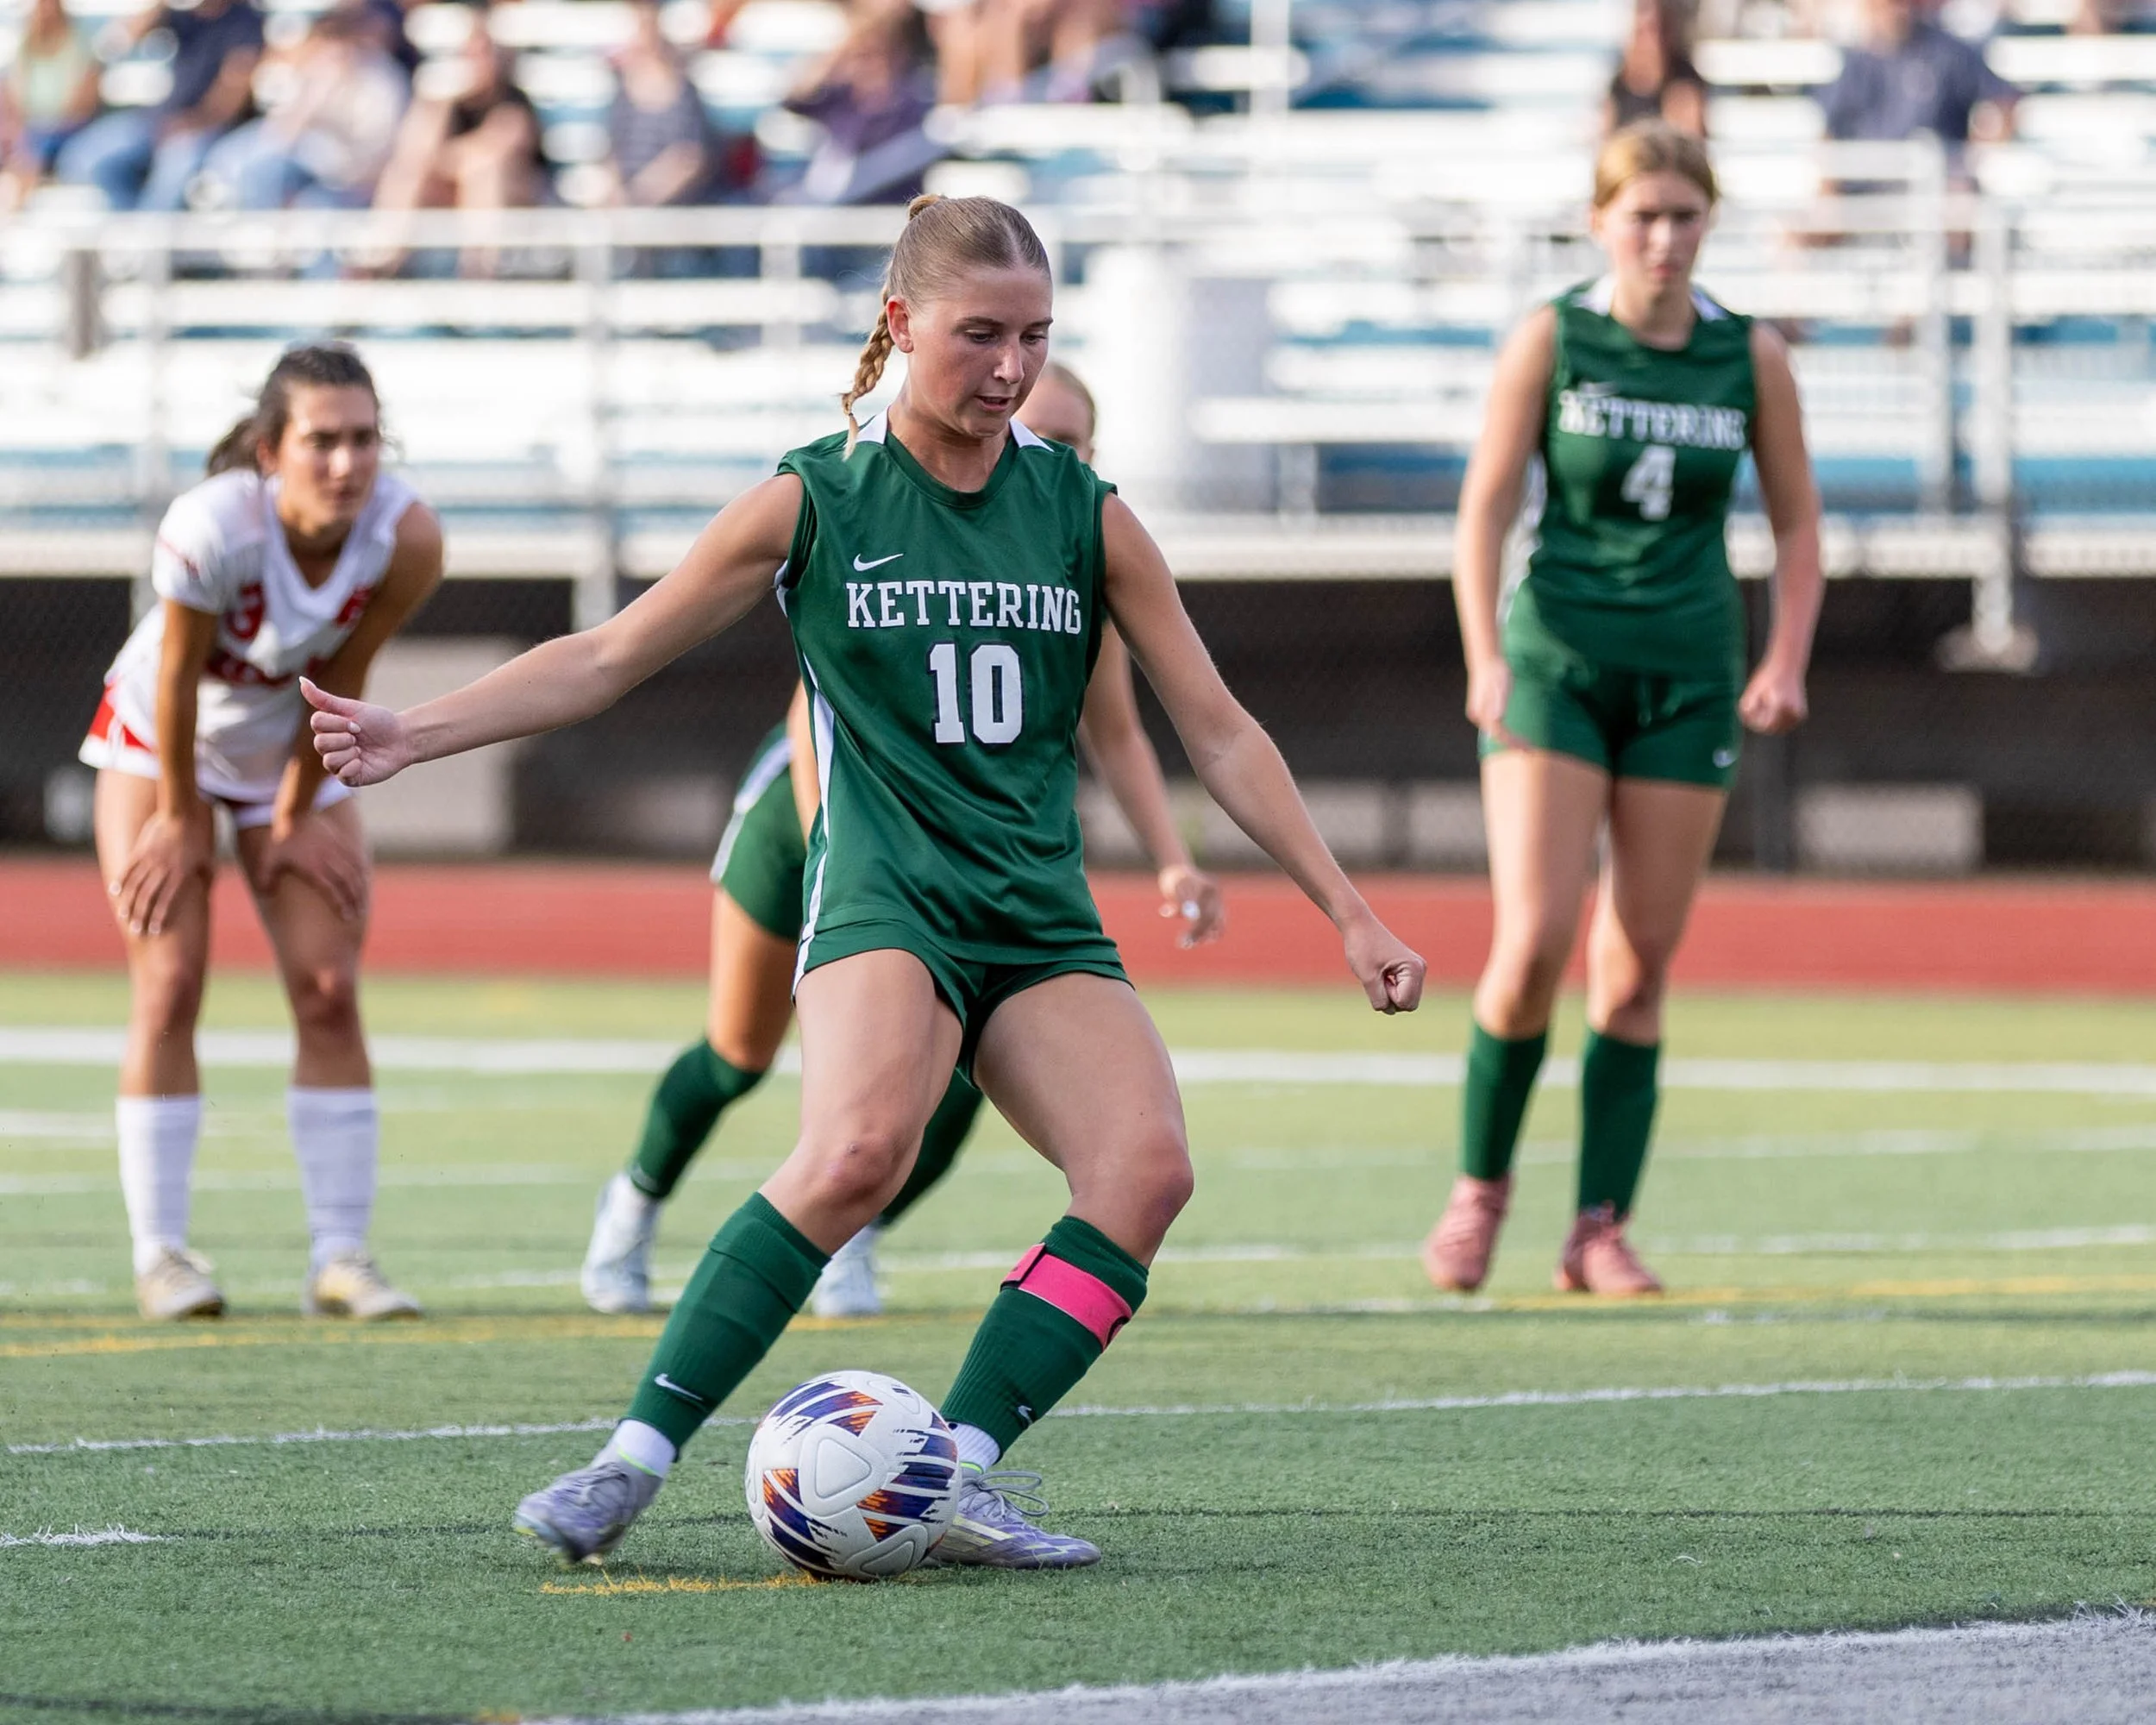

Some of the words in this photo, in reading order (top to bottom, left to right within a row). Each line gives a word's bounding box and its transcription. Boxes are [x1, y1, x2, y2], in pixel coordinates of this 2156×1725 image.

[1620, 444, 1677, 521] 4
[845, 580, 1082, 635] KETTERING
[929, 643, 1024, 744] 10
